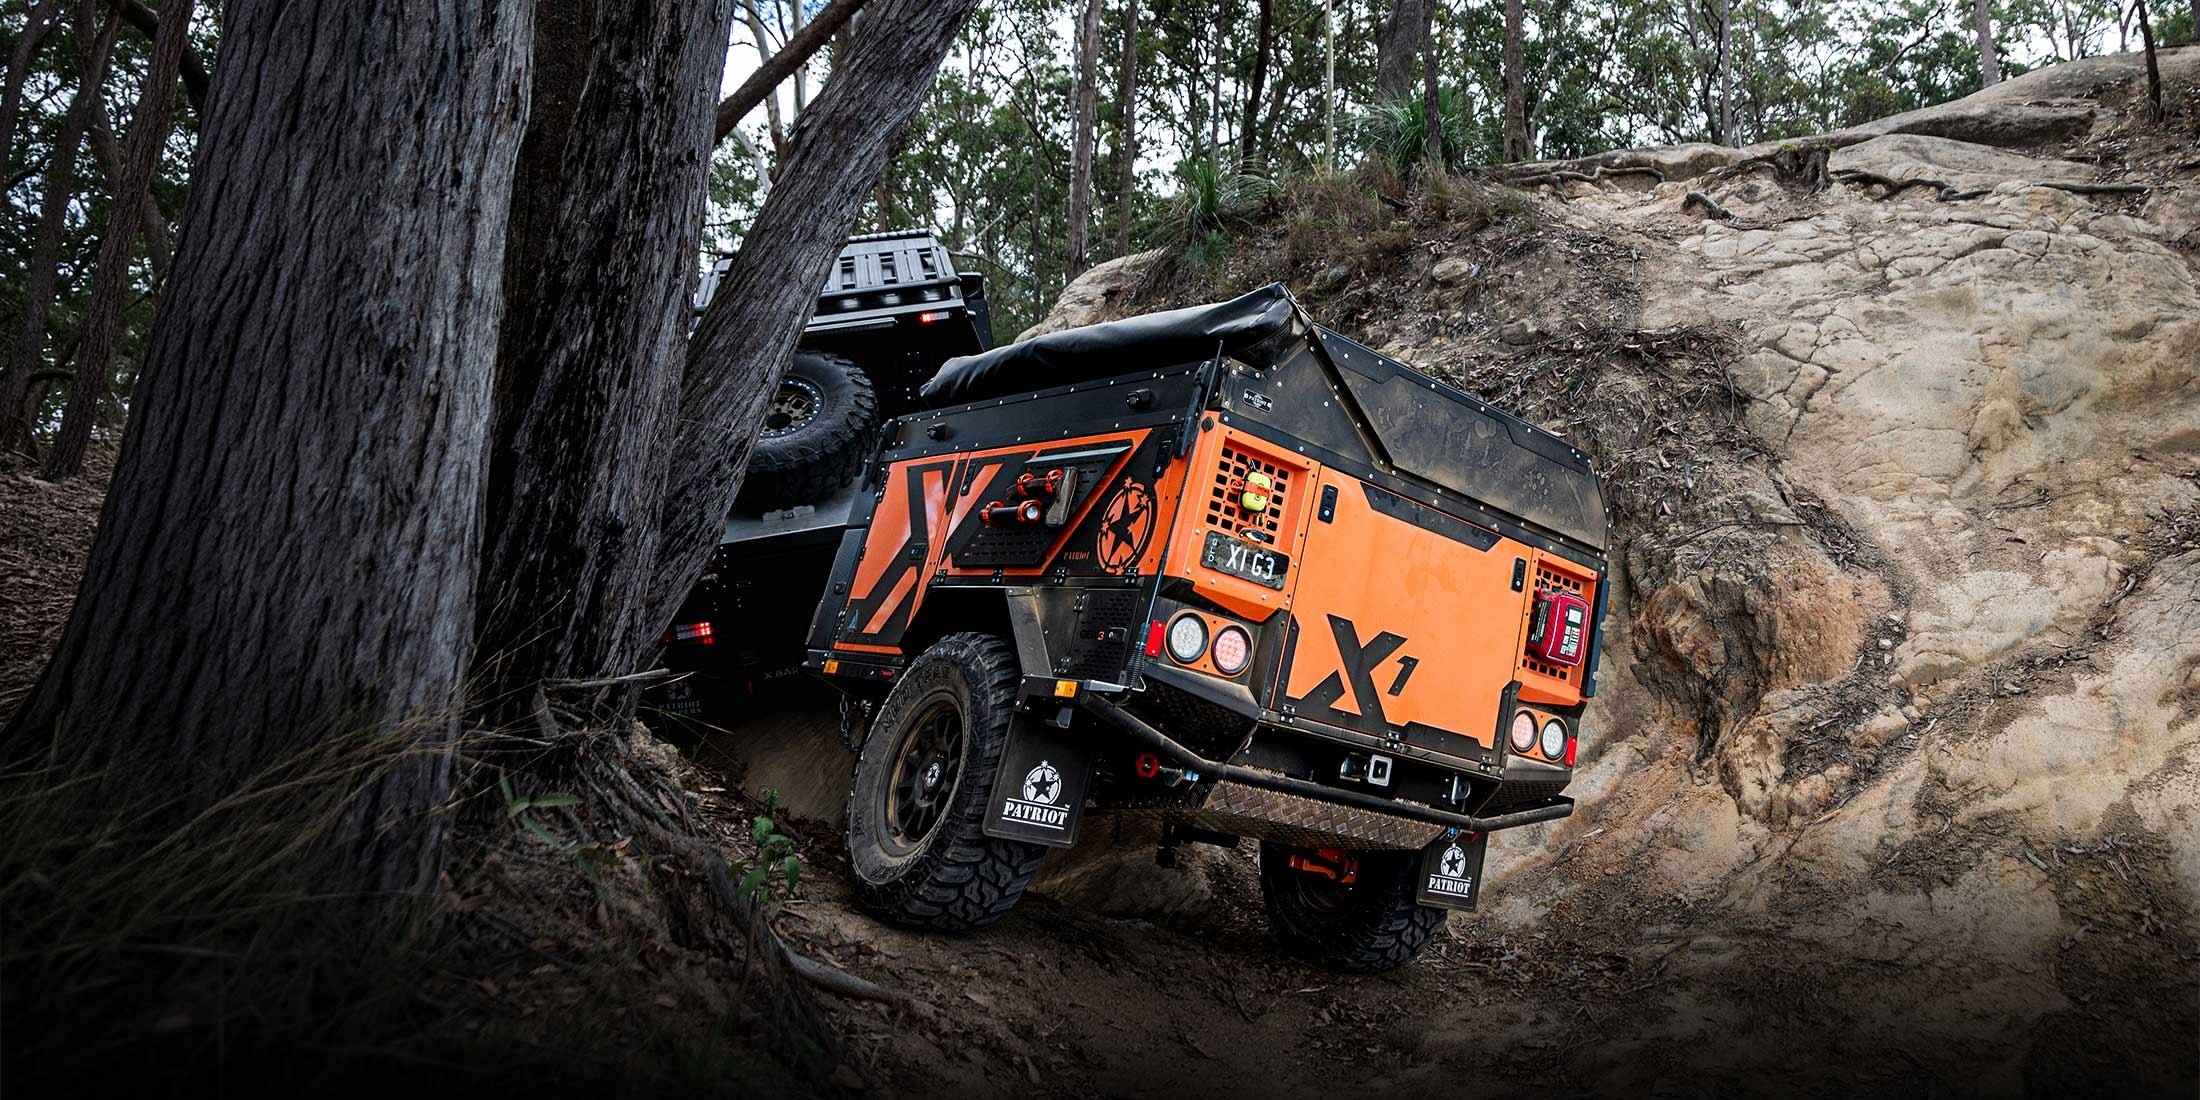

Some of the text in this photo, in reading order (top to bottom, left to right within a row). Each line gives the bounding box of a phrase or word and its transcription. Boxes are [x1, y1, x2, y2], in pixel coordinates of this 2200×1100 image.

[1251, 553, 1275, 580] G3
[1003, 801, 1068, 825] PATRIOT
[1428, 877, 1471, 894] PATRIOT
